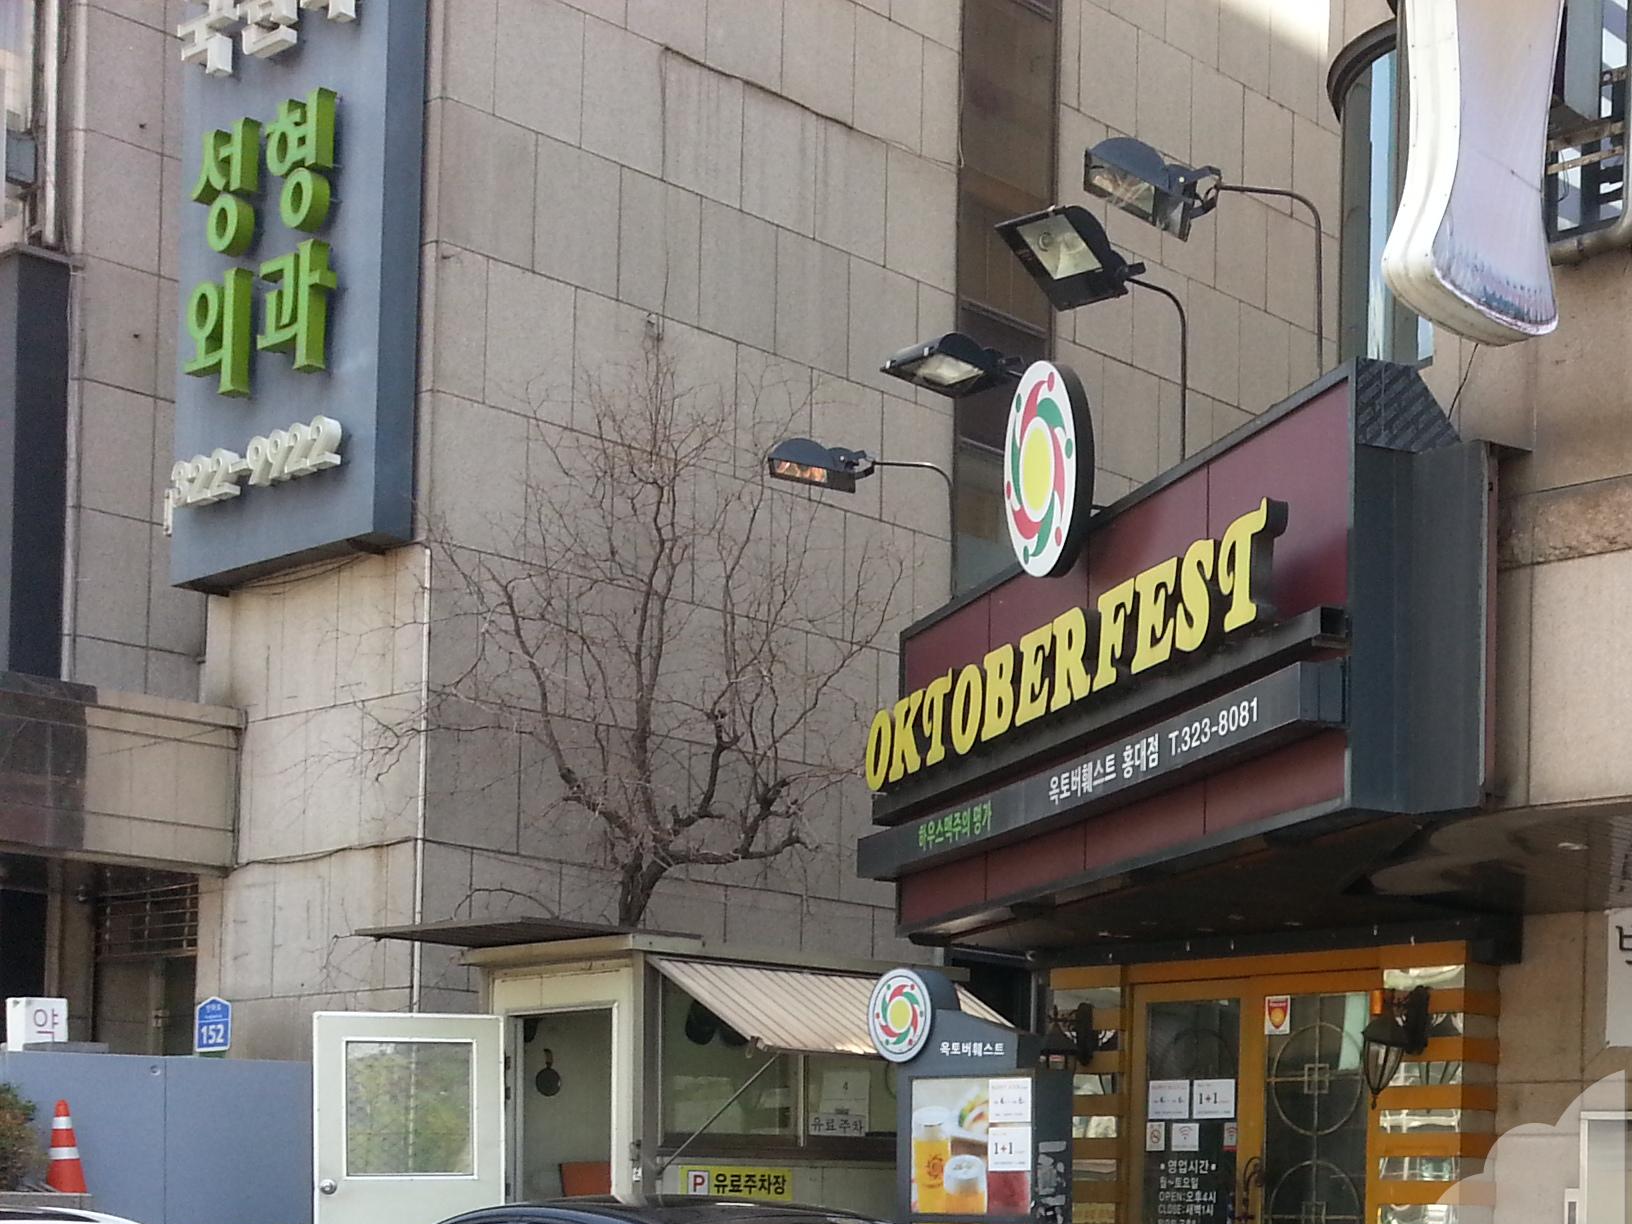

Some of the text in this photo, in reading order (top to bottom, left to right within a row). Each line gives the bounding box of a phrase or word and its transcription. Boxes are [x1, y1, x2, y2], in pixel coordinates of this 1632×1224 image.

[192, 87, 340, 258] 성형
[183, 238, 338, 398] 외과
[171, 414, 343, 508] 322-9922
[865, 497, 1270, 792] OKTOBERFEST
[1122, 734, 1160, 780] 홍대점
[1168, 696, 1259, 758] T.323-8081
[918, 800, 993, 851] 하우스맥주의 명가
[33, 1008, 59, 1042] 약
[201, 1024, 225, 1044] 152
[692, 1173, 788, 1196] P 유료주차장
[1167, 1160, 1209, 1174] 영업시간
